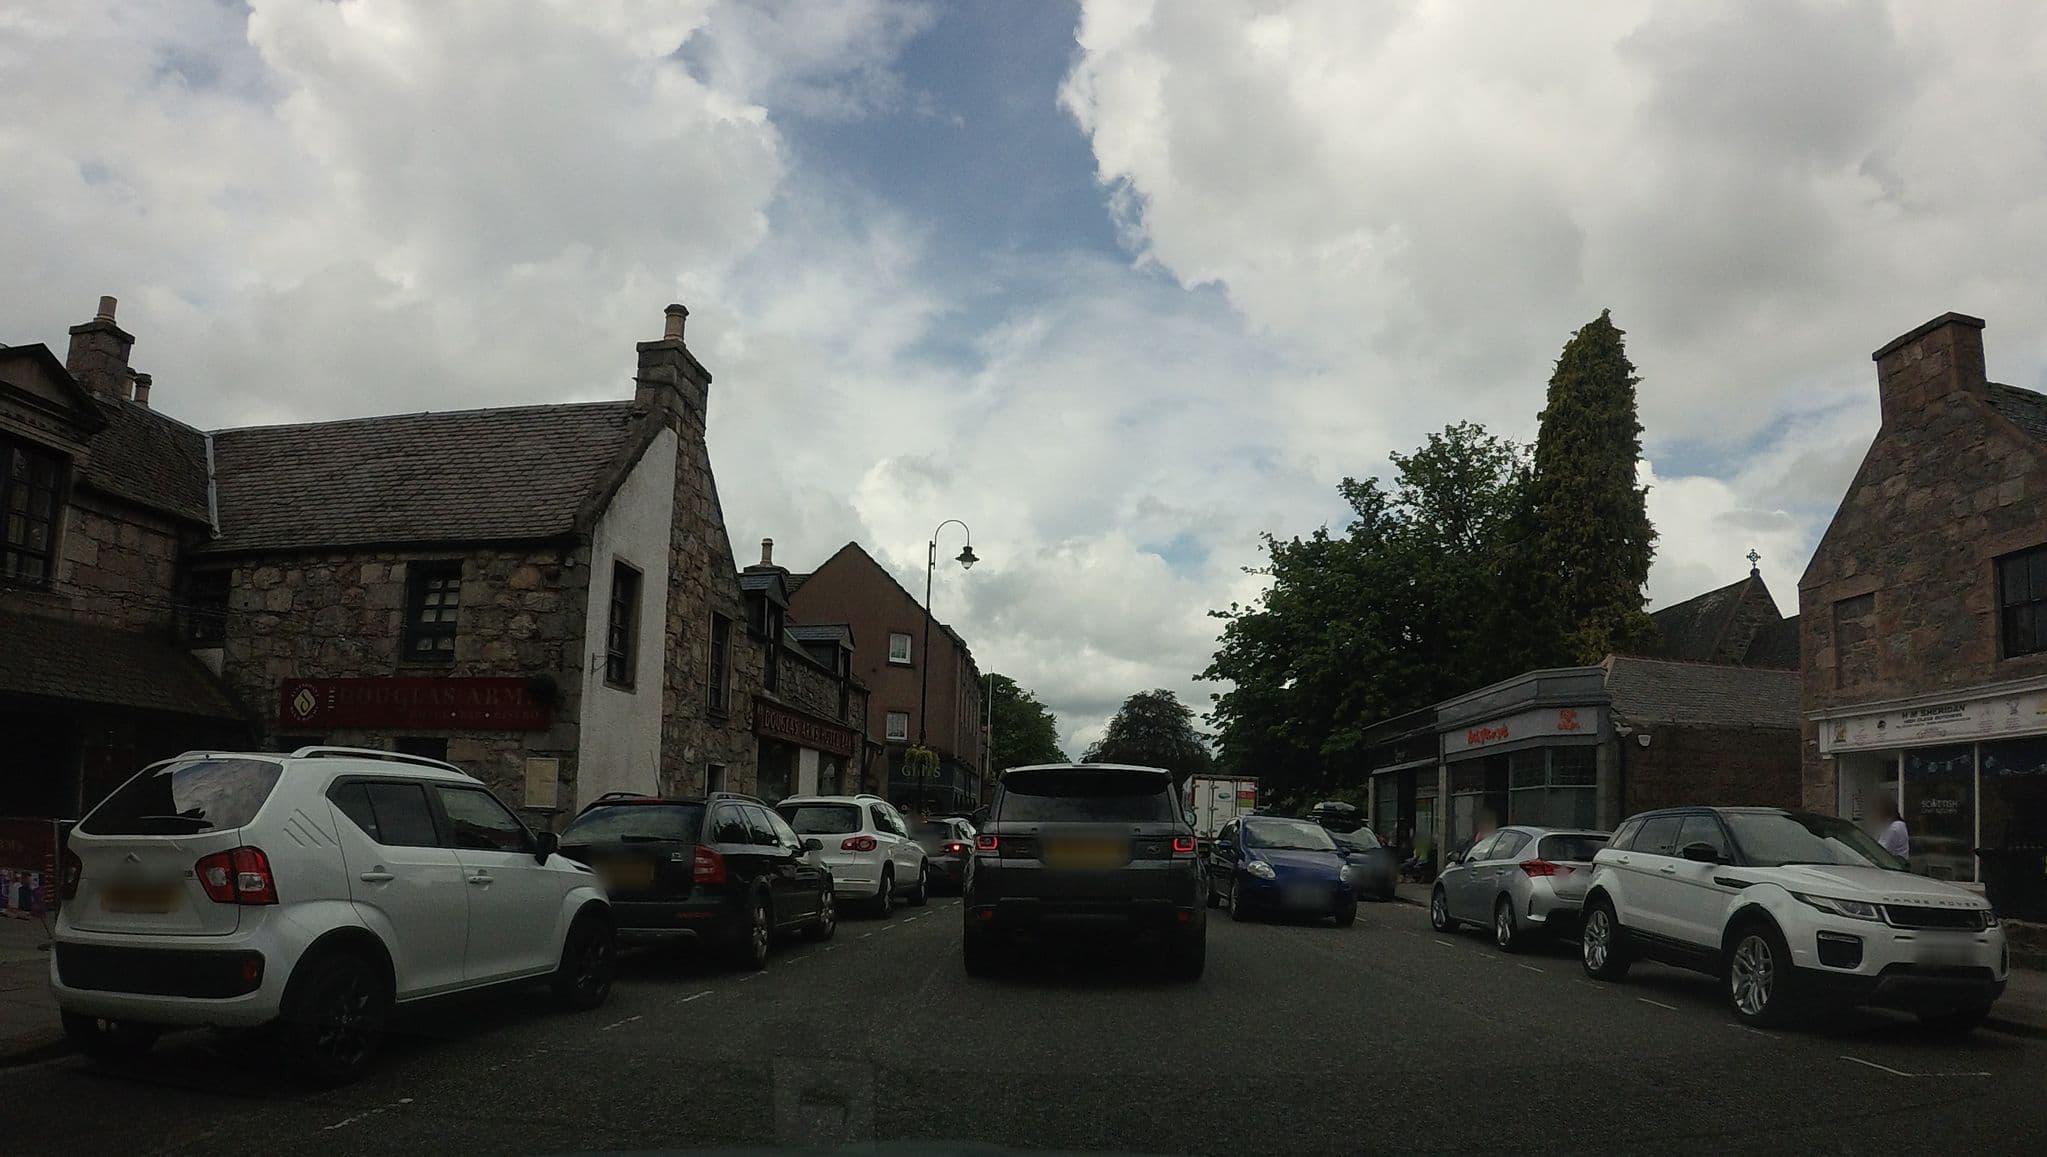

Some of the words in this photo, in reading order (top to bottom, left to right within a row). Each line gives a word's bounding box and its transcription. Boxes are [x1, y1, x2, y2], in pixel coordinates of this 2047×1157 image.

[466, 686, 533, 705] ARM
[1920, 703, 1966, 717] SHERIDAN
[765, 709, 798, 737] DOUGLAS
[1883, 897, 1930, 905] RANGE
